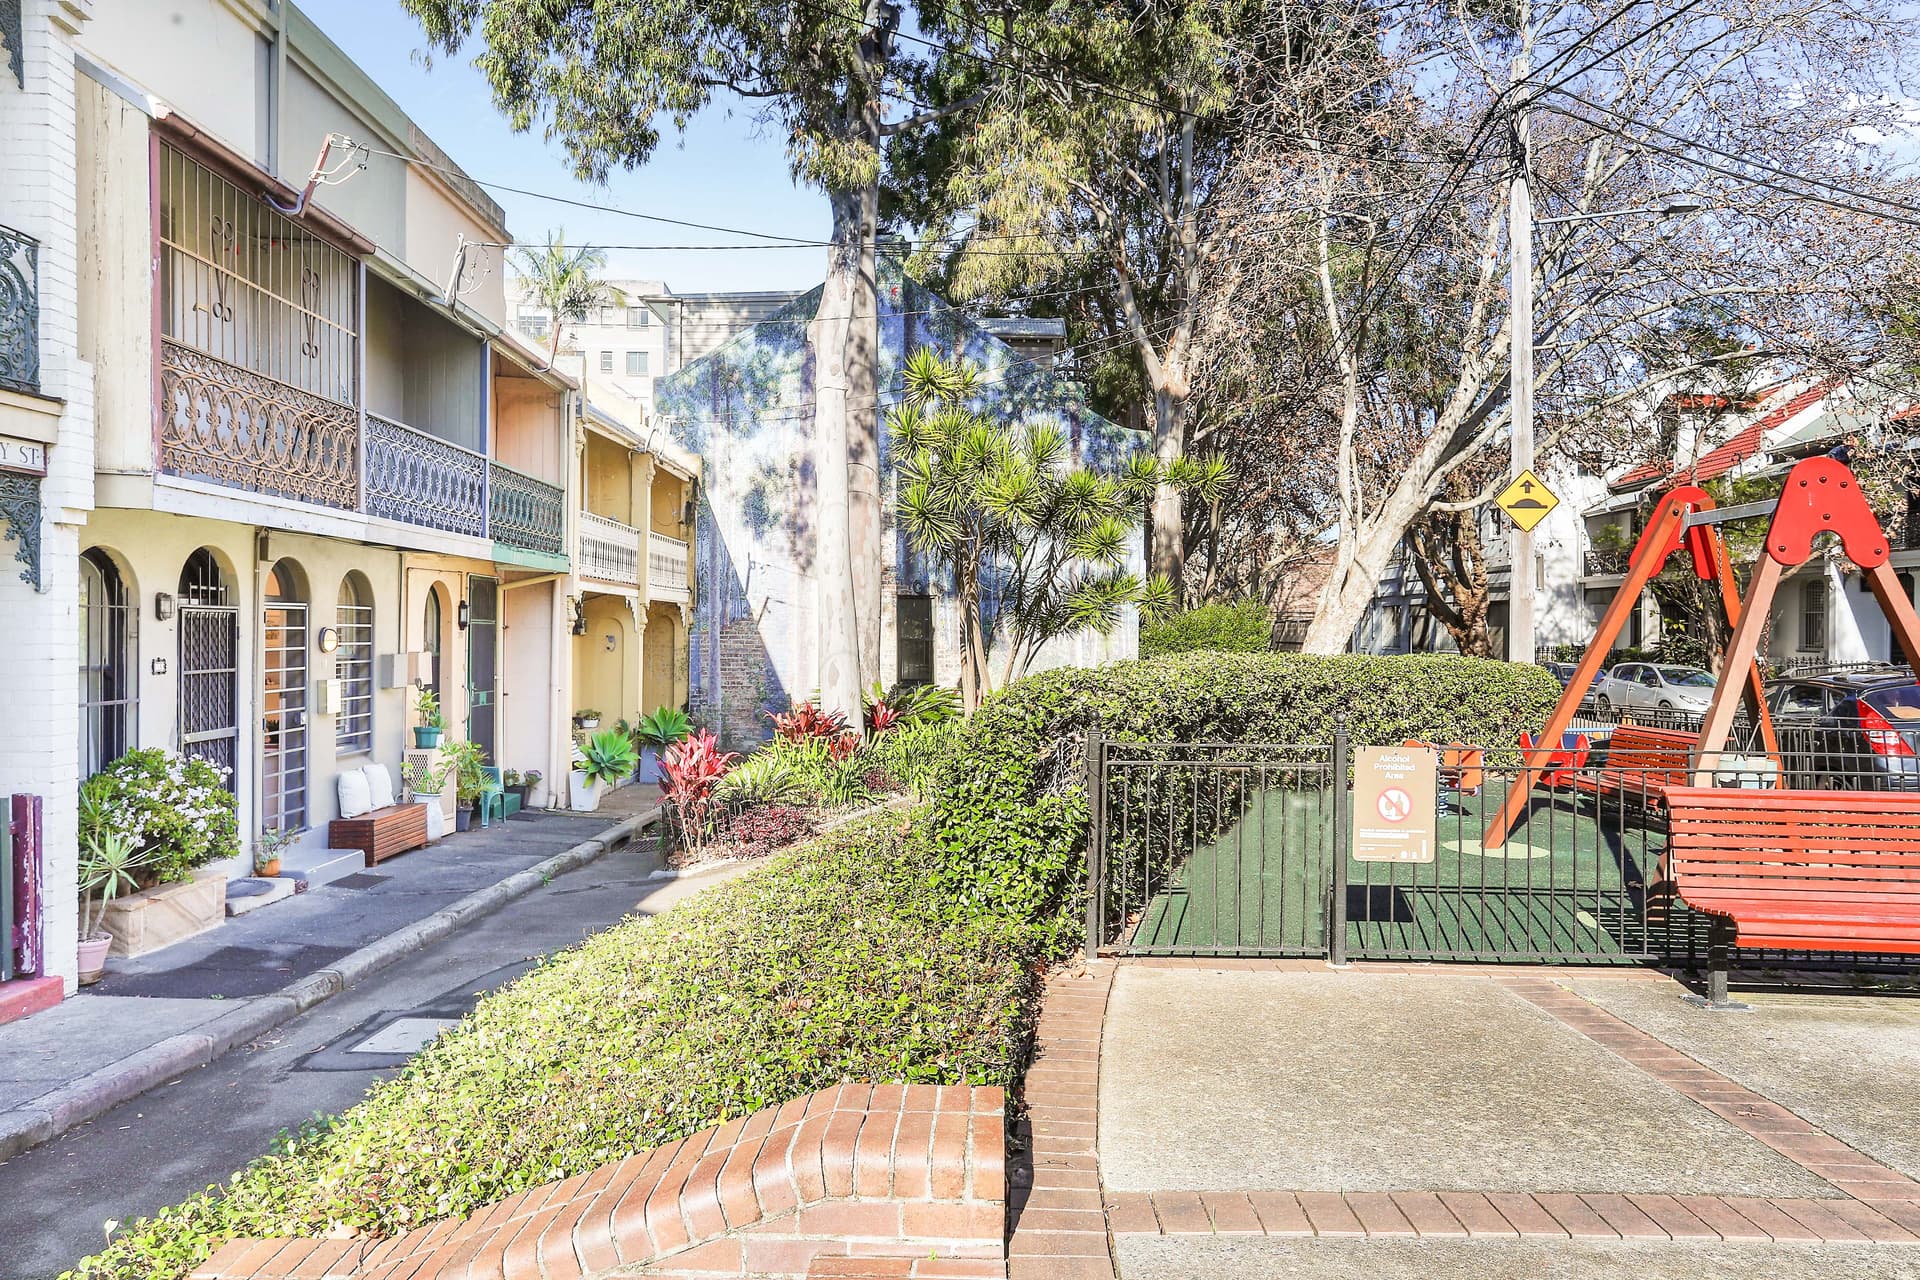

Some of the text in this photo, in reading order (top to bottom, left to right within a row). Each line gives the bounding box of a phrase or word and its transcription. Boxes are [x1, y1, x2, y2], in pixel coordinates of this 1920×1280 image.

[1379, 754, 1410, 763] Alcohol
[1374, 762, 1416, 771] Prohibited
[1385, 771, 1404, 779] Area
